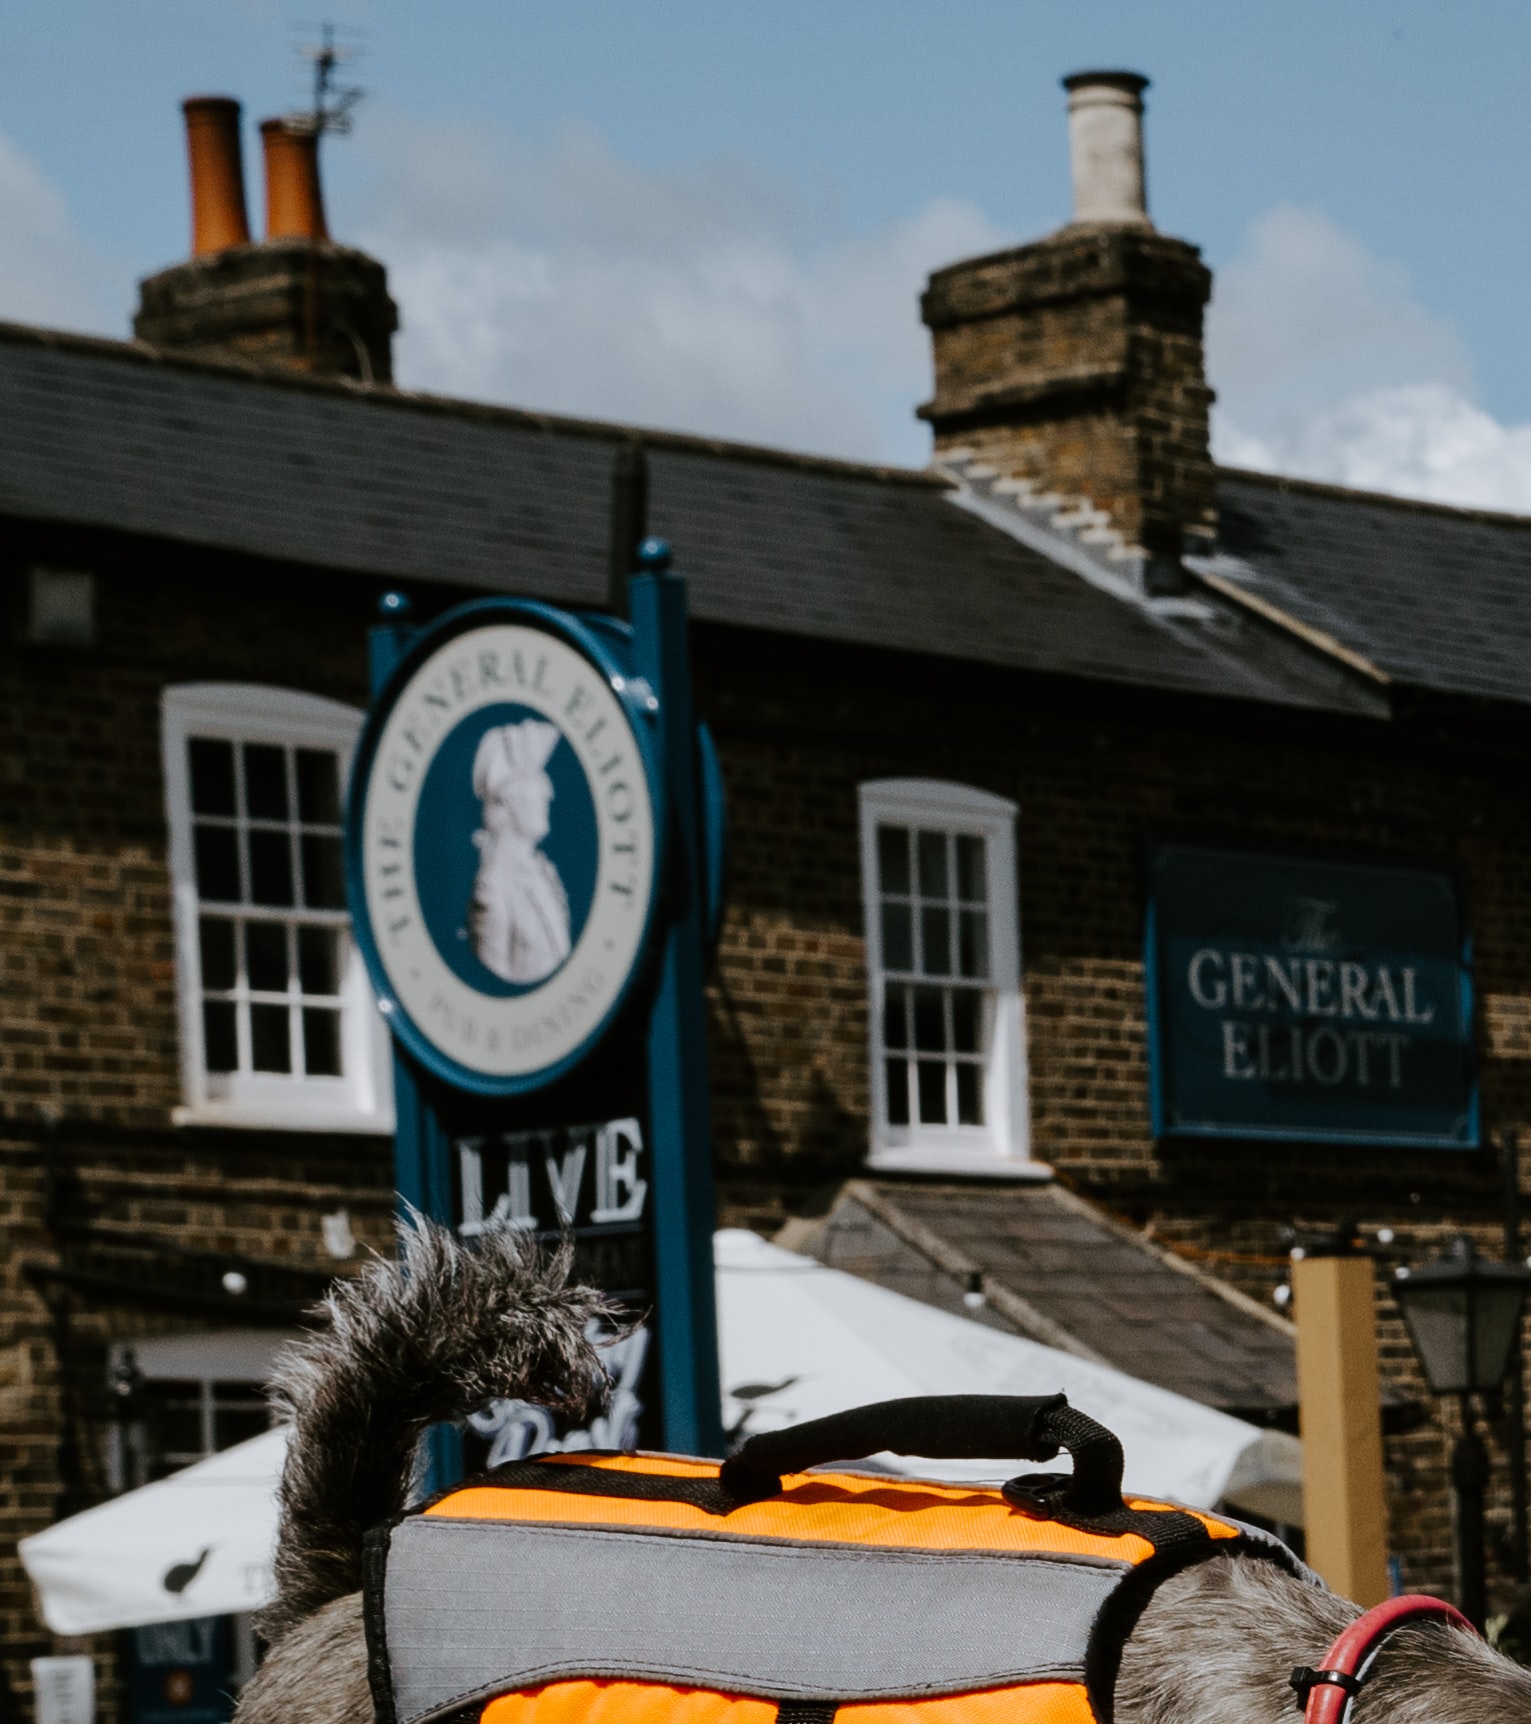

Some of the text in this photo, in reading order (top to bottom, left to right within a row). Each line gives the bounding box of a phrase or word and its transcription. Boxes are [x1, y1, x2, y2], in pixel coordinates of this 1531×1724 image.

[377, 647, 640, 945] THE GENERAL ELIOTT
[1186, 949, 1437, 1024] GENERAL
[1221, 1020, 1409, 1089] ELIOTT
[456, 1117, 648, 1237] LIVE
